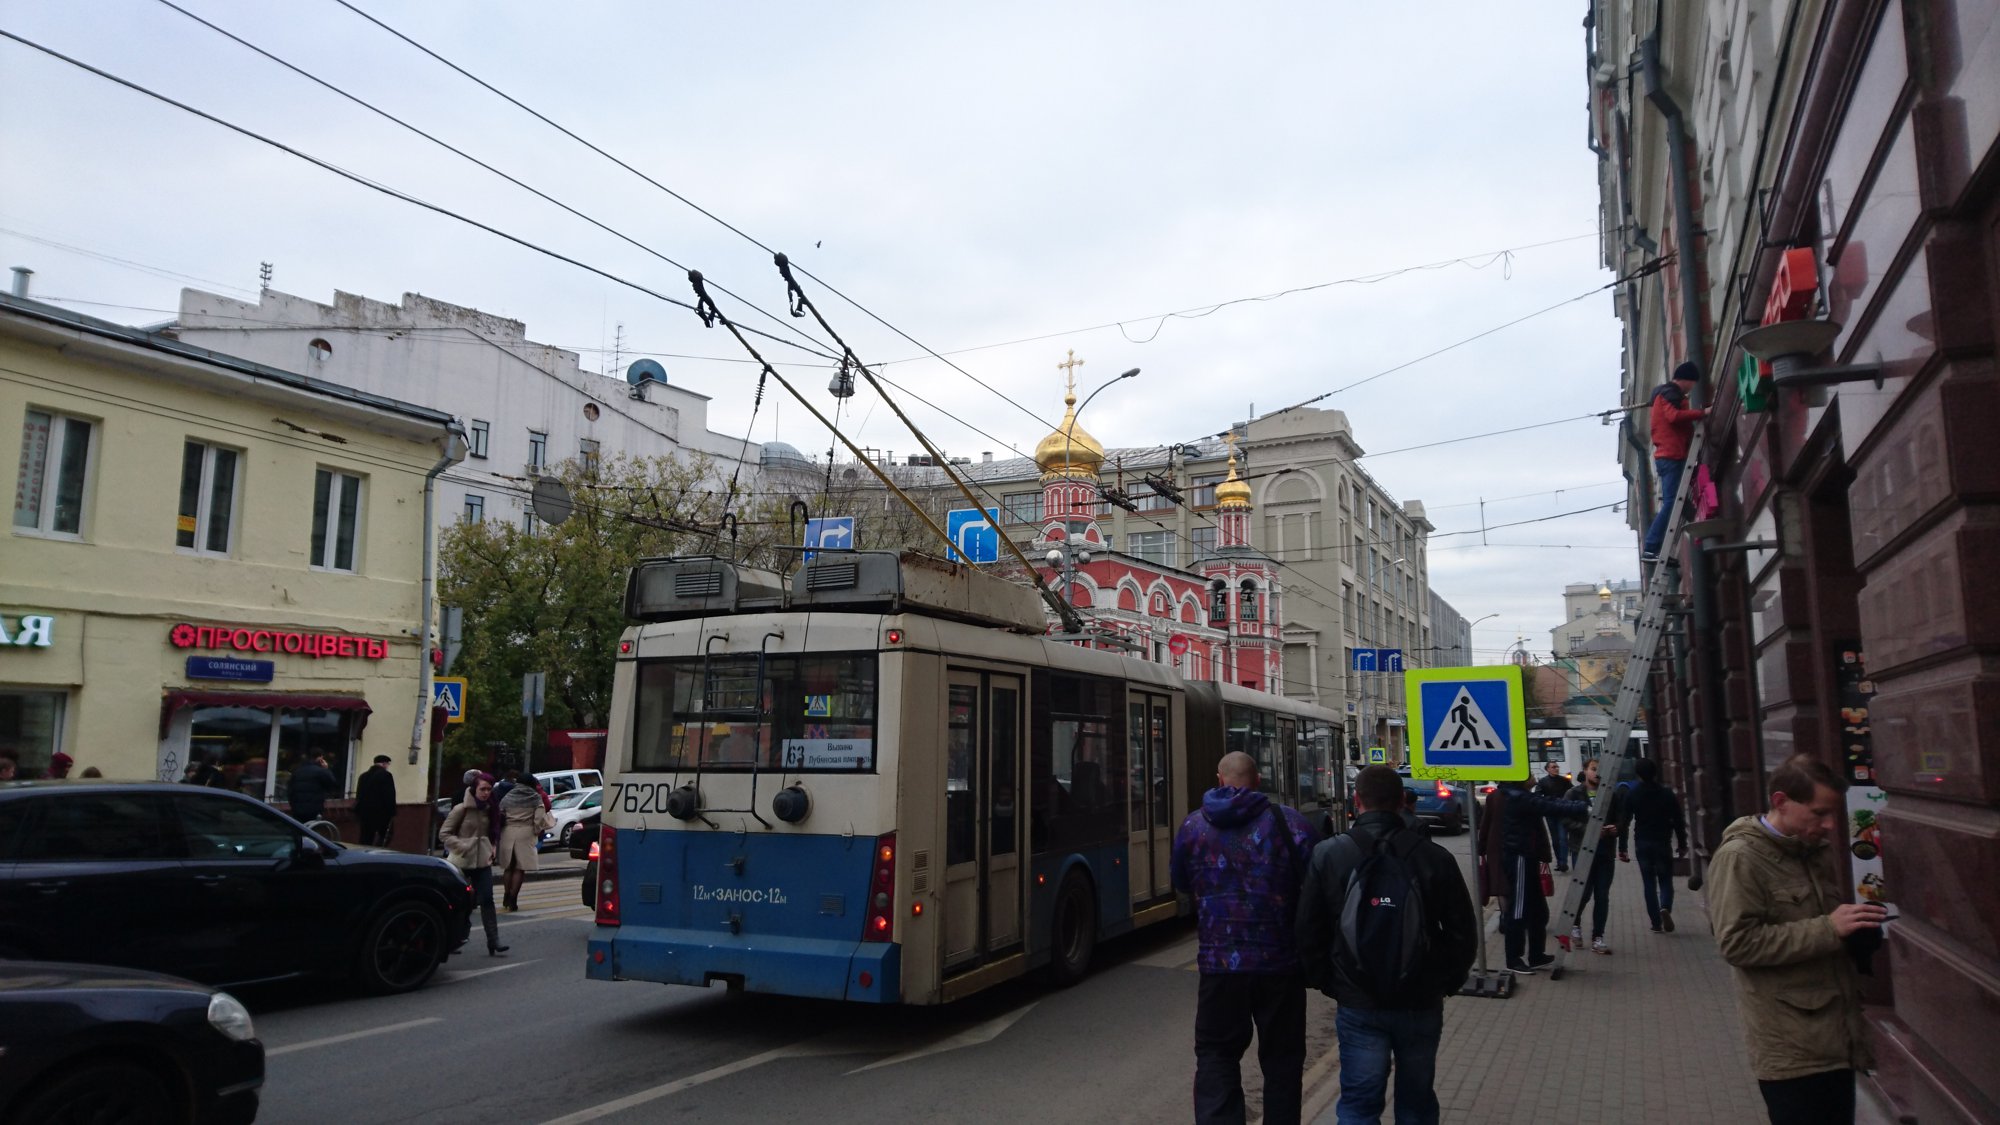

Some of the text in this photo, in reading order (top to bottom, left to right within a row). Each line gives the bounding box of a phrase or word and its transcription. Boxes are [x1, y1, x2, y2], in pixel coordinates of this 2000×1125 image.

[196, 625, 388, 659] ПРОСТОЦВЕТЫ
[208, 661, 257, 672] СОЛЯНСКИЙ
[609, 783, 670, 813] 7620
[716, 888, 763, 902] ЗАНОС
